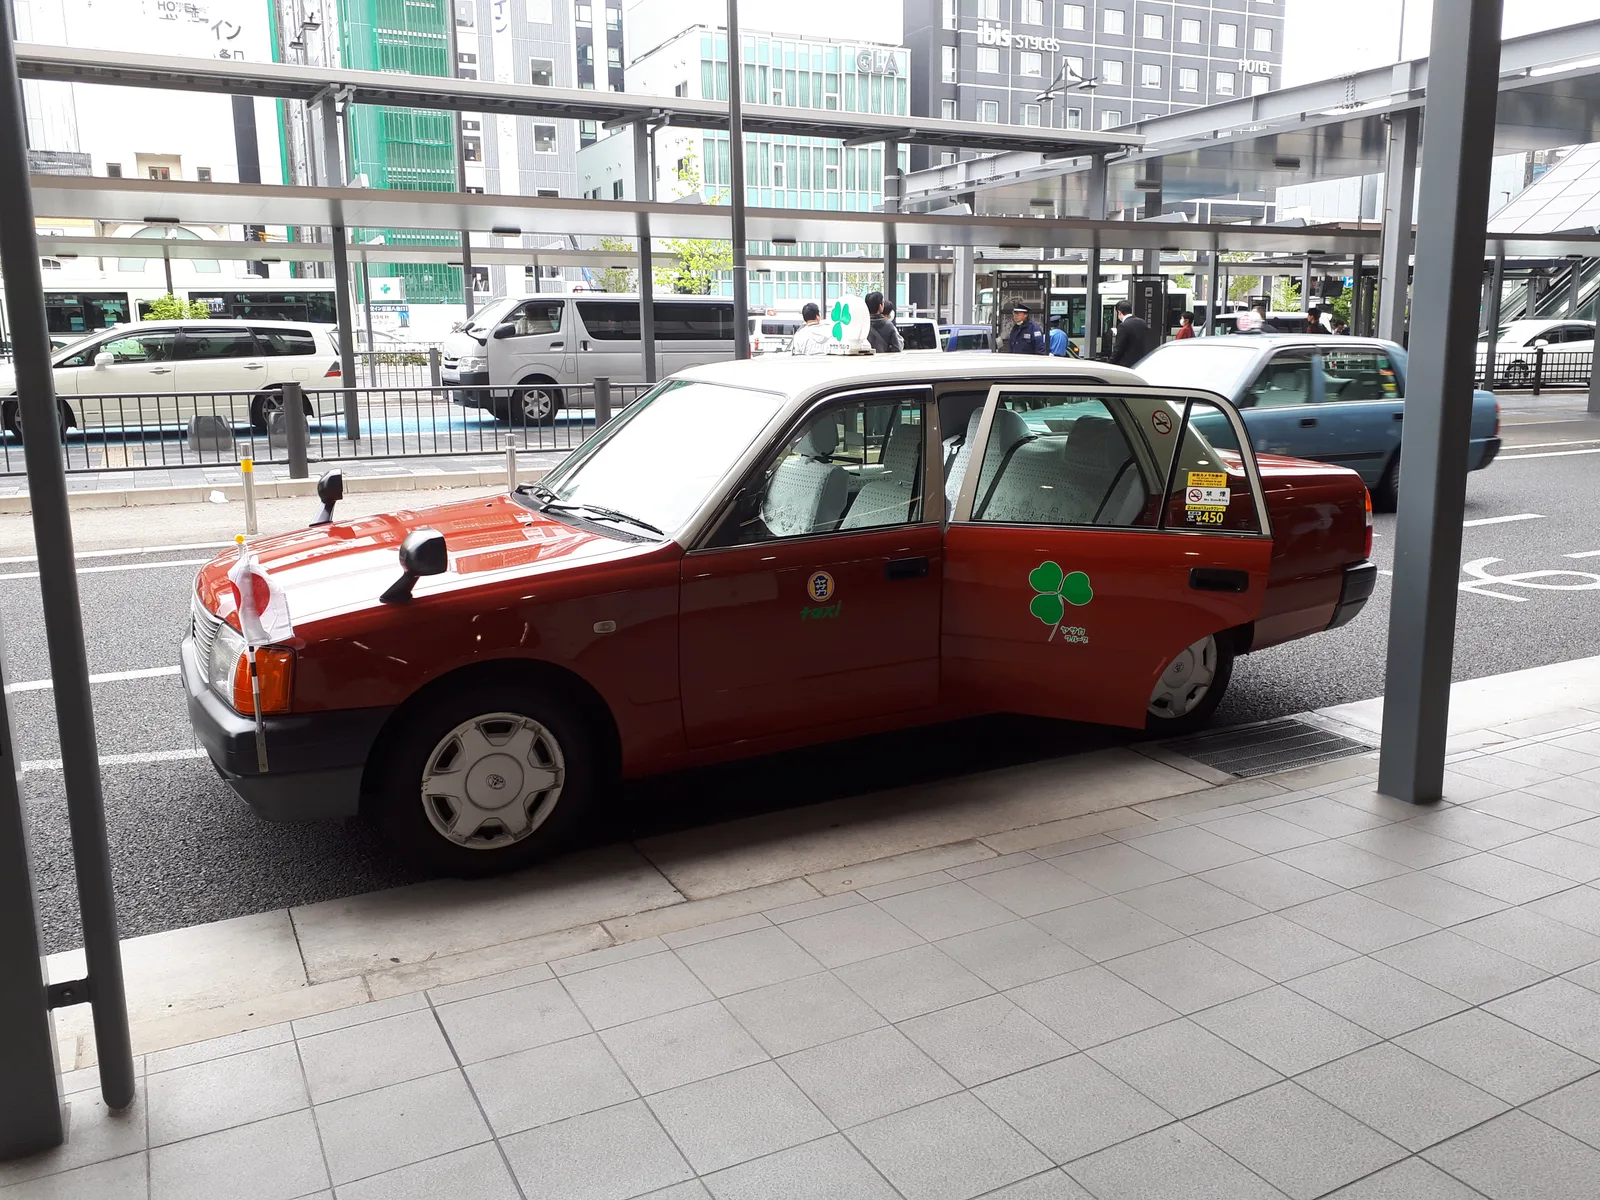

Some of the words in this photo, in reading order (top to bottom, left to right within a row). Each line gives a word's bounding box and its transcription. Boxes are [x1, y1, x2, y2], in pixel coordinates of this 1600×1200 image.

[977, 20, 1011, 47] ibis
[857, 50, 899, 75] GLA
[1238, 59, 1272, 74] HOTEL
[800, 600, 842, 621] taxi
[1060, 625, 1086, 636] ヤサカ
